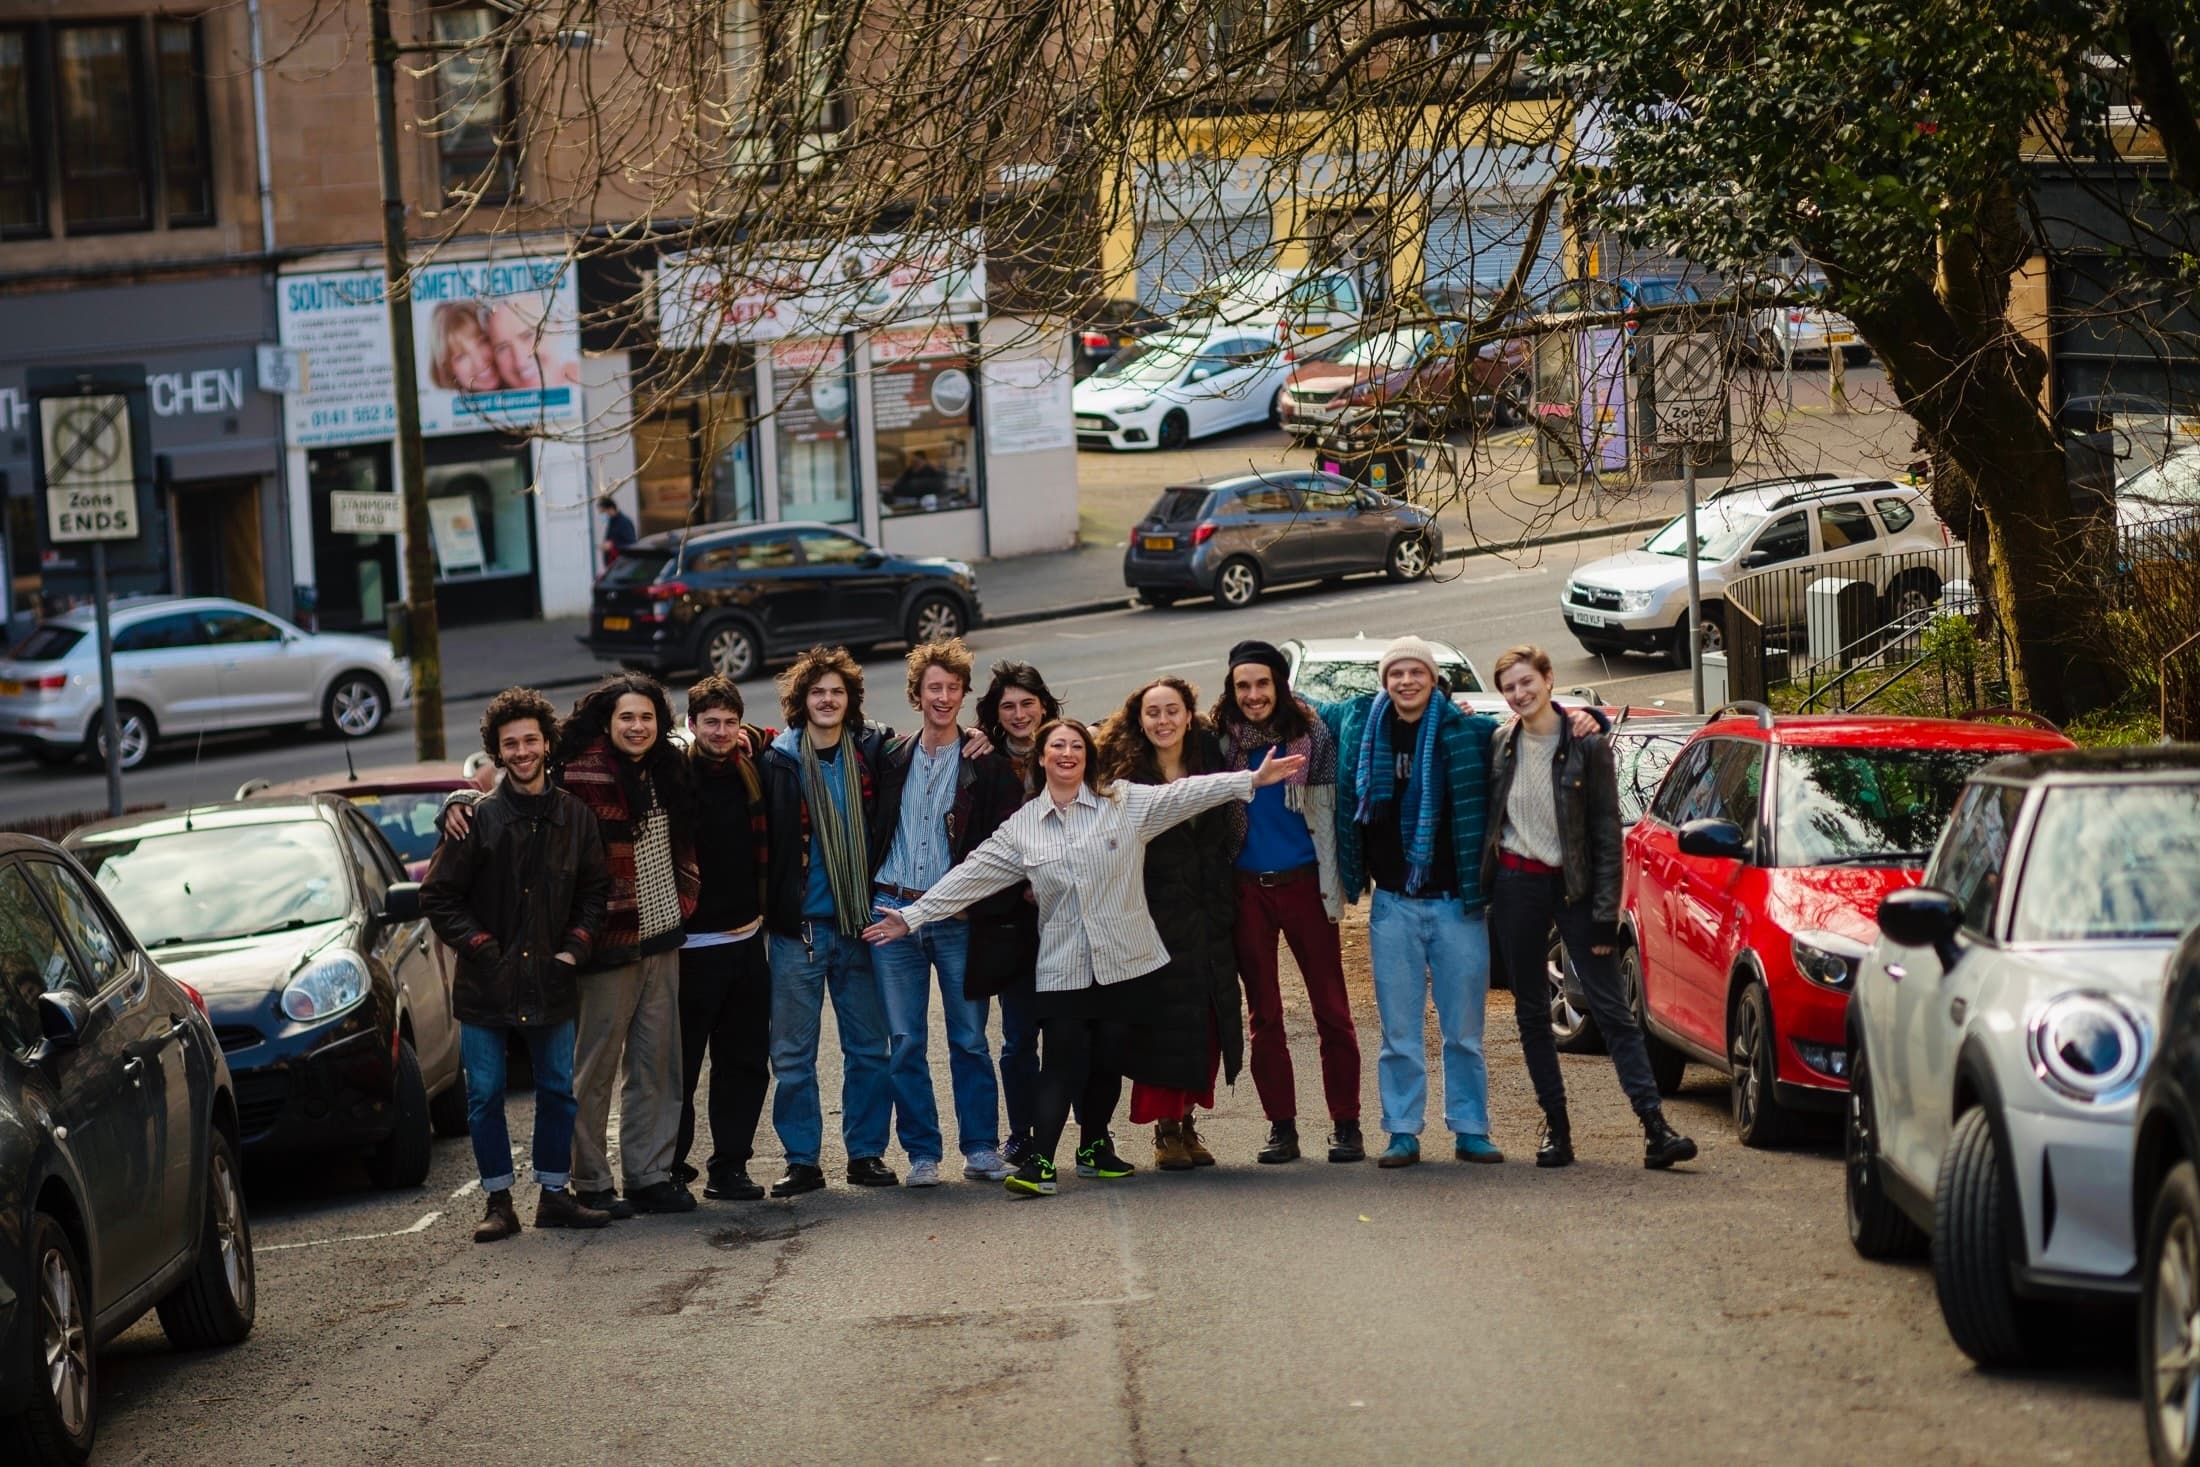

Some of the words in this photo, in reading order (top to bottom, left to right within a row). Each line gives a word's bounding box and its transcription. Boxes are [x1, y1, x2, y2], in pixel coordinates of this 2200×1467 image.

[411, 267, 476, 302] SMETIC
[147, 368, 243, 416] CHEN
[69, 492, 113, 510] Zone
[341, 499, 400, 512] STANMORE
[59, 510, 128, 533] ENDS
[356, 514, 385, 525] ROAD
